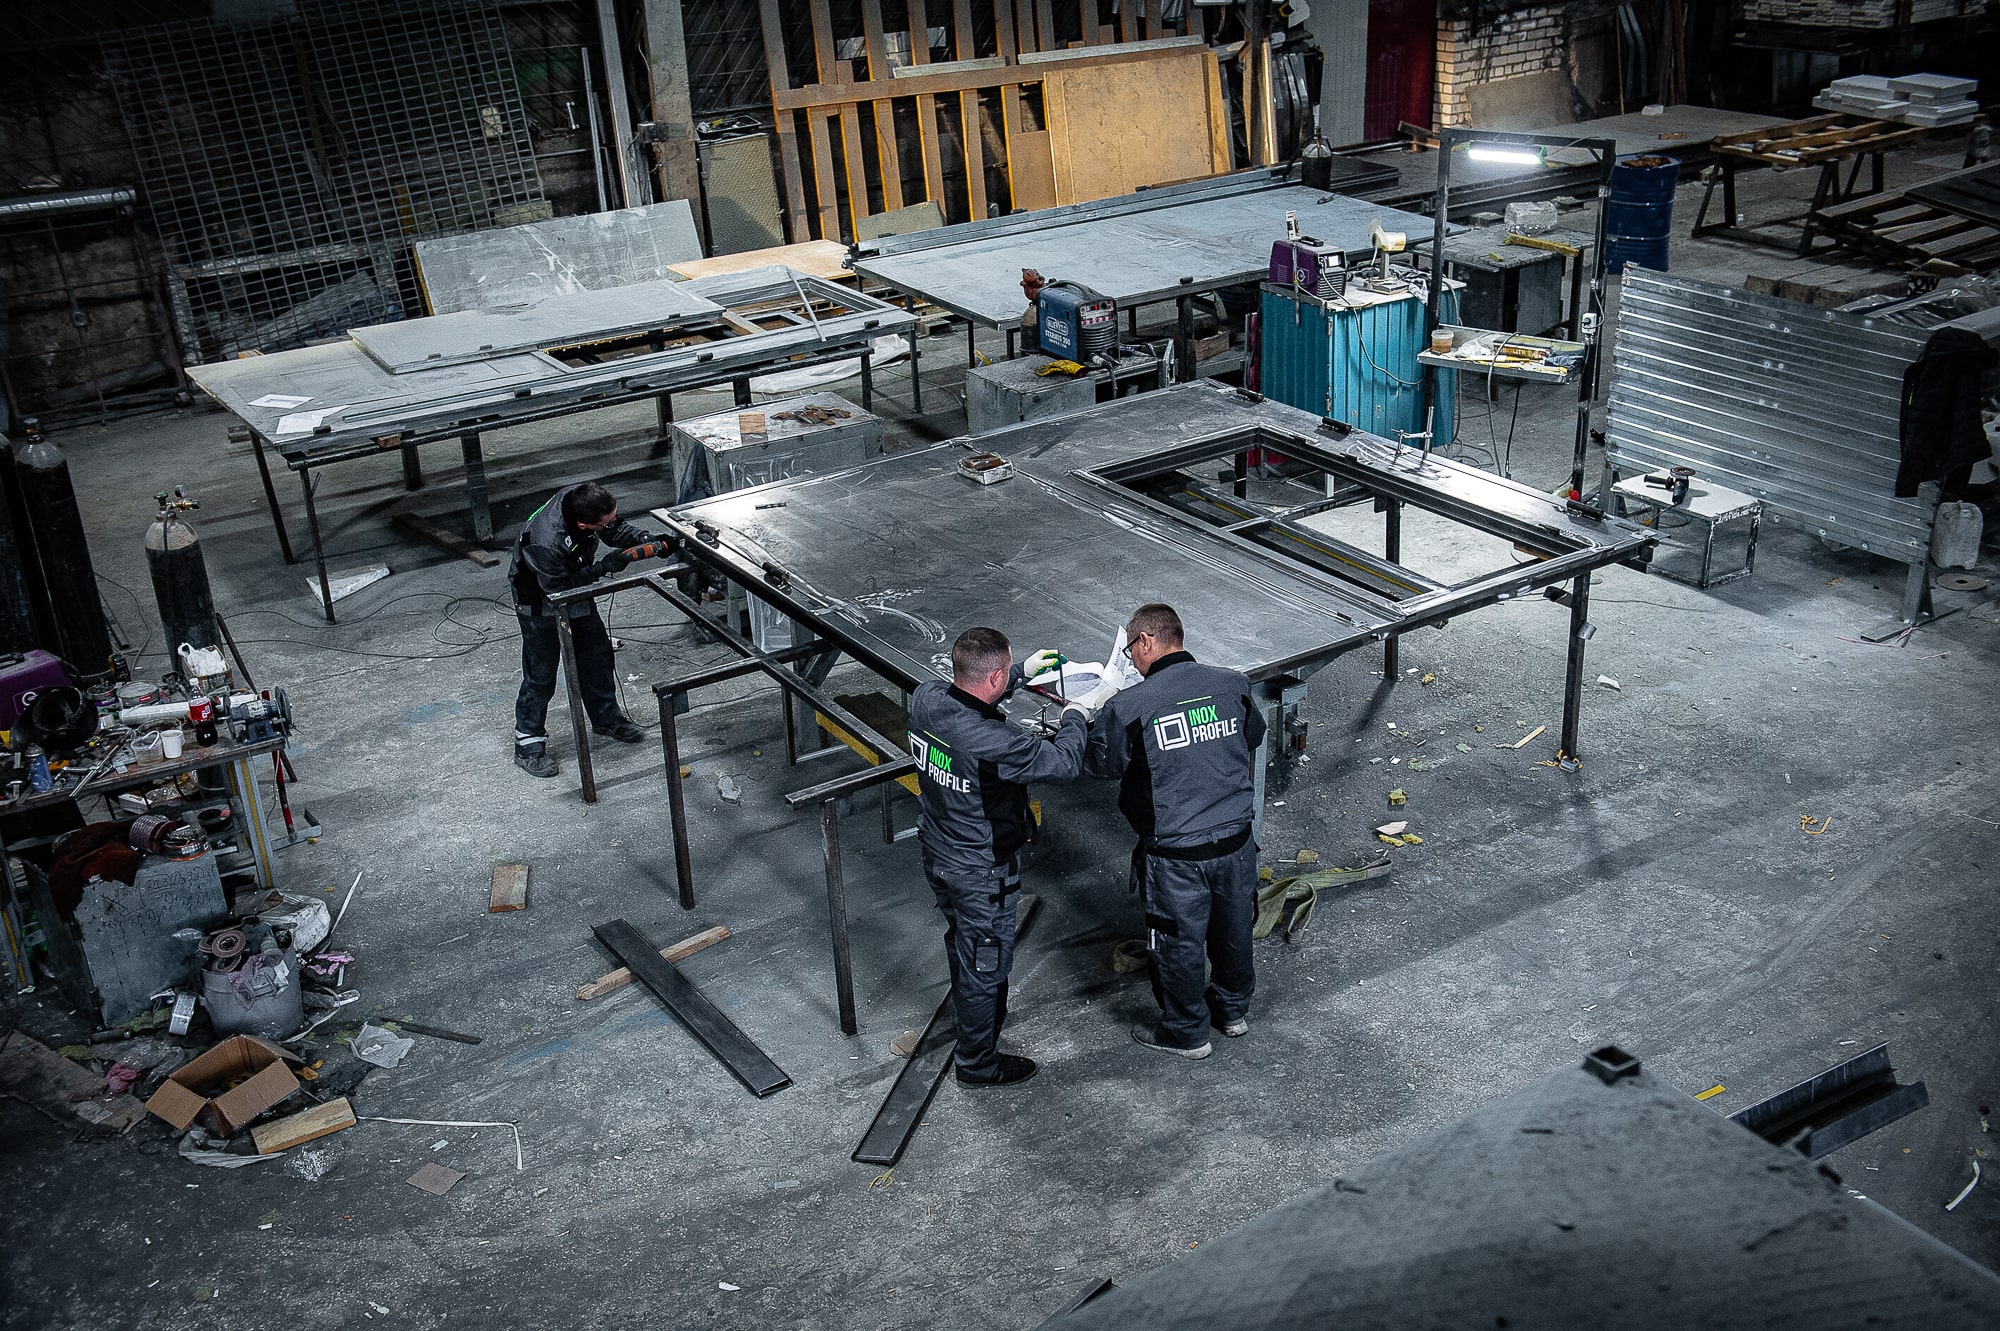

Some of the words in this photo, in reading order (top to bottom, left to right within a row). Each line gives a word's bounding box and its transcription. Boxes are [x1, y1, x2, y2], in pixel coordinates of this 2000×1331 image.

[1188, 705, 1218, 726] INOX
[1191, 717, 1238, 744] PROFILE
[929, 746, 952, 773] INOX
[928, 761, 971, 793] PROFILE
